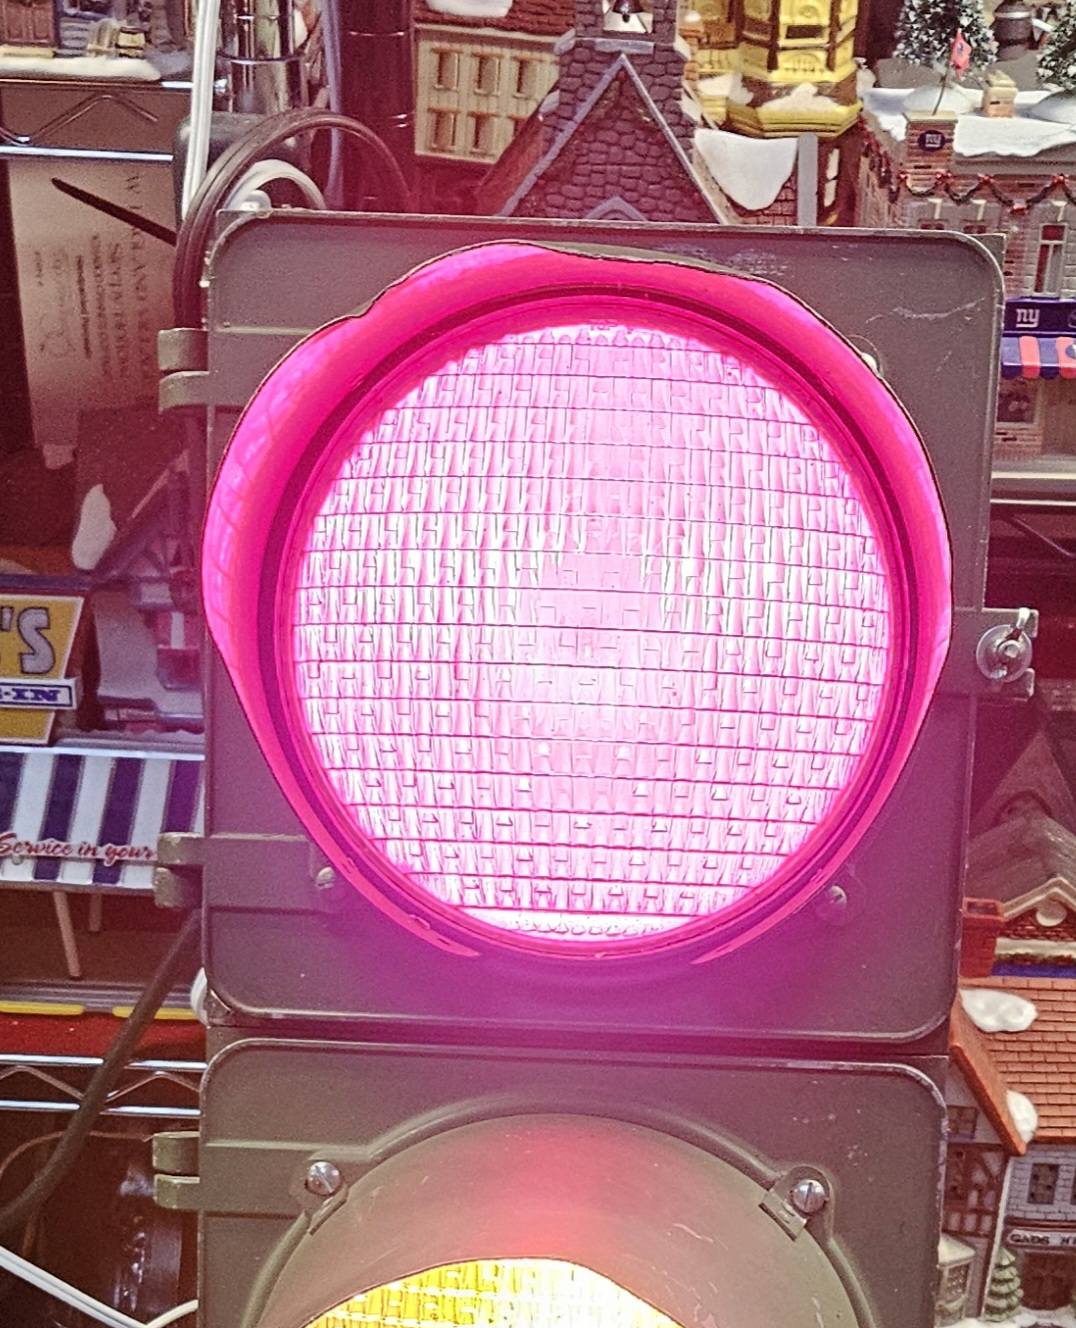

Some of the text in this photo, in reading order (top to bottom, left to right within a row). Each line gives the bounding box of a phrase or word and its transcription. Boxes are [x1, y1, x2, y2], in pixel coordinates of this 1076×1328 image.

[0, 687, 60, 703] -IN
[0, 832, 154, 866] Service in your
